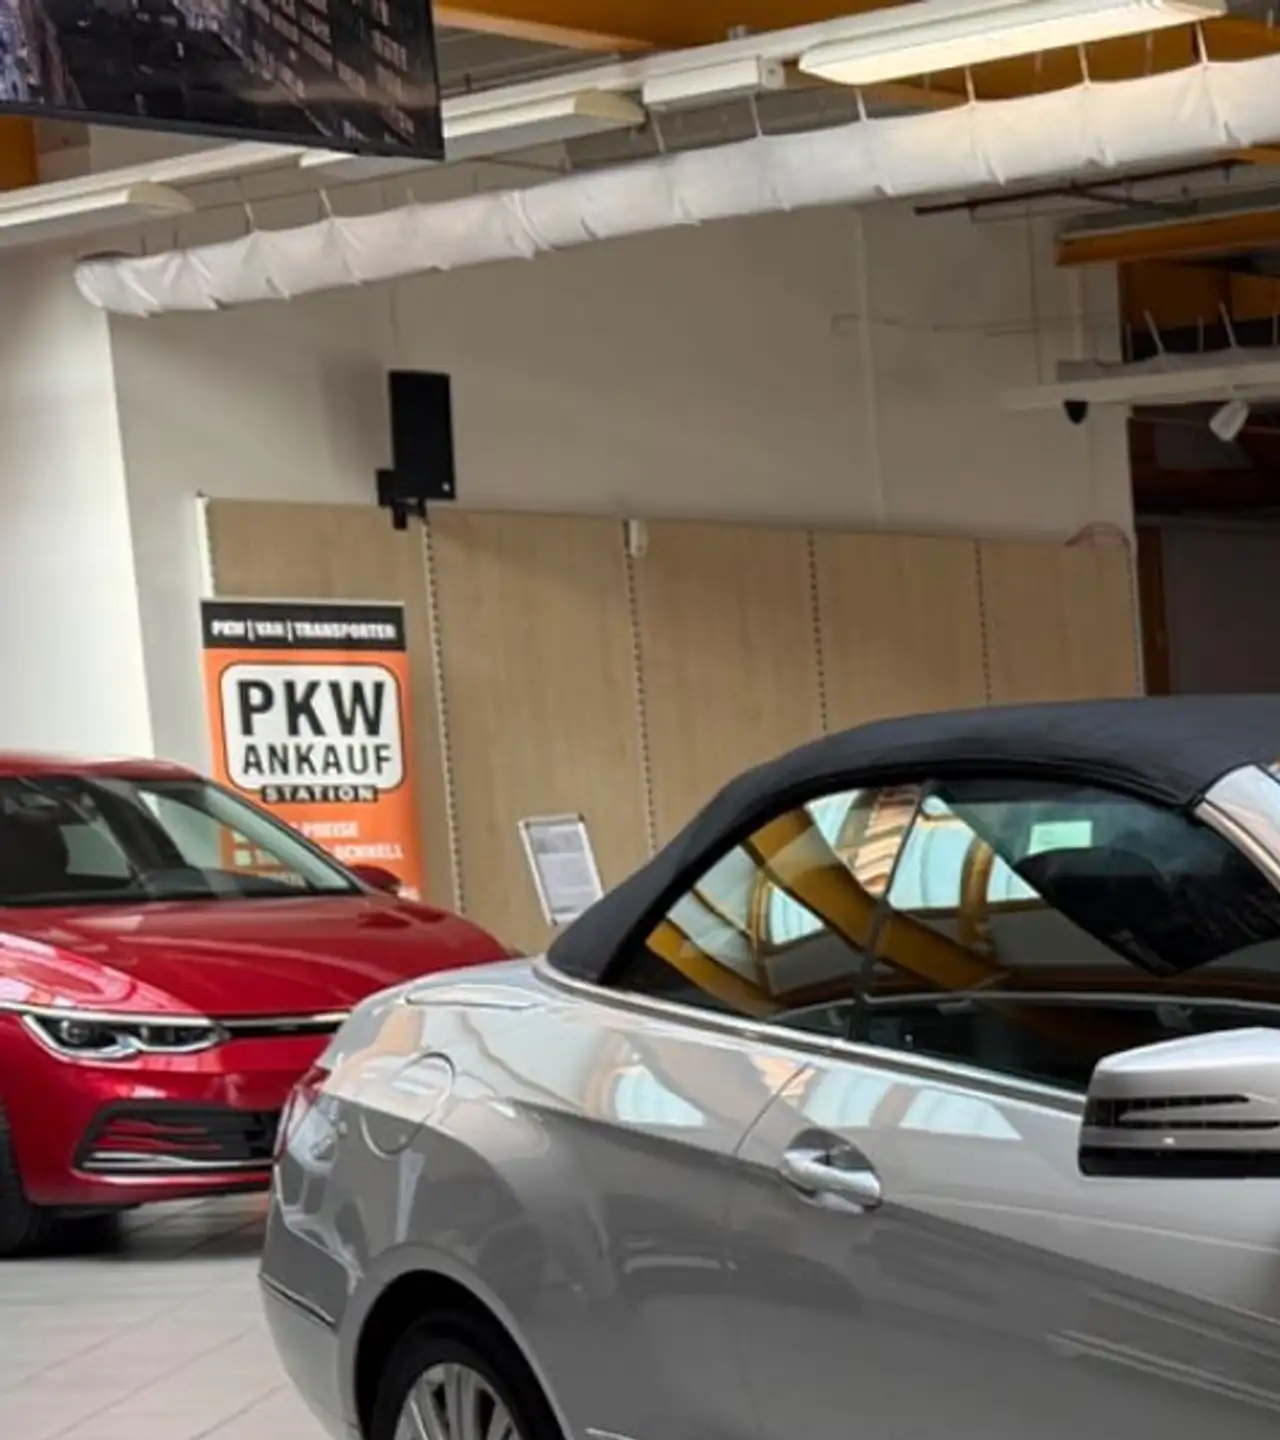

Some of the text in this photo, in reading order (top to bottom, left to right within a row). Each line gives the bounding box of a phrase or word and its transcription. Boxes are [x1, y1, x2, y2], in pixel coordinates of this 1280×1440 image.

[293, 622, 397, 640] TRANSPORTER
[237, 679, 385, 737] PKW
[242, 743, 392, 776] ANKAUF
[264, 786, 375, 802] STATION
